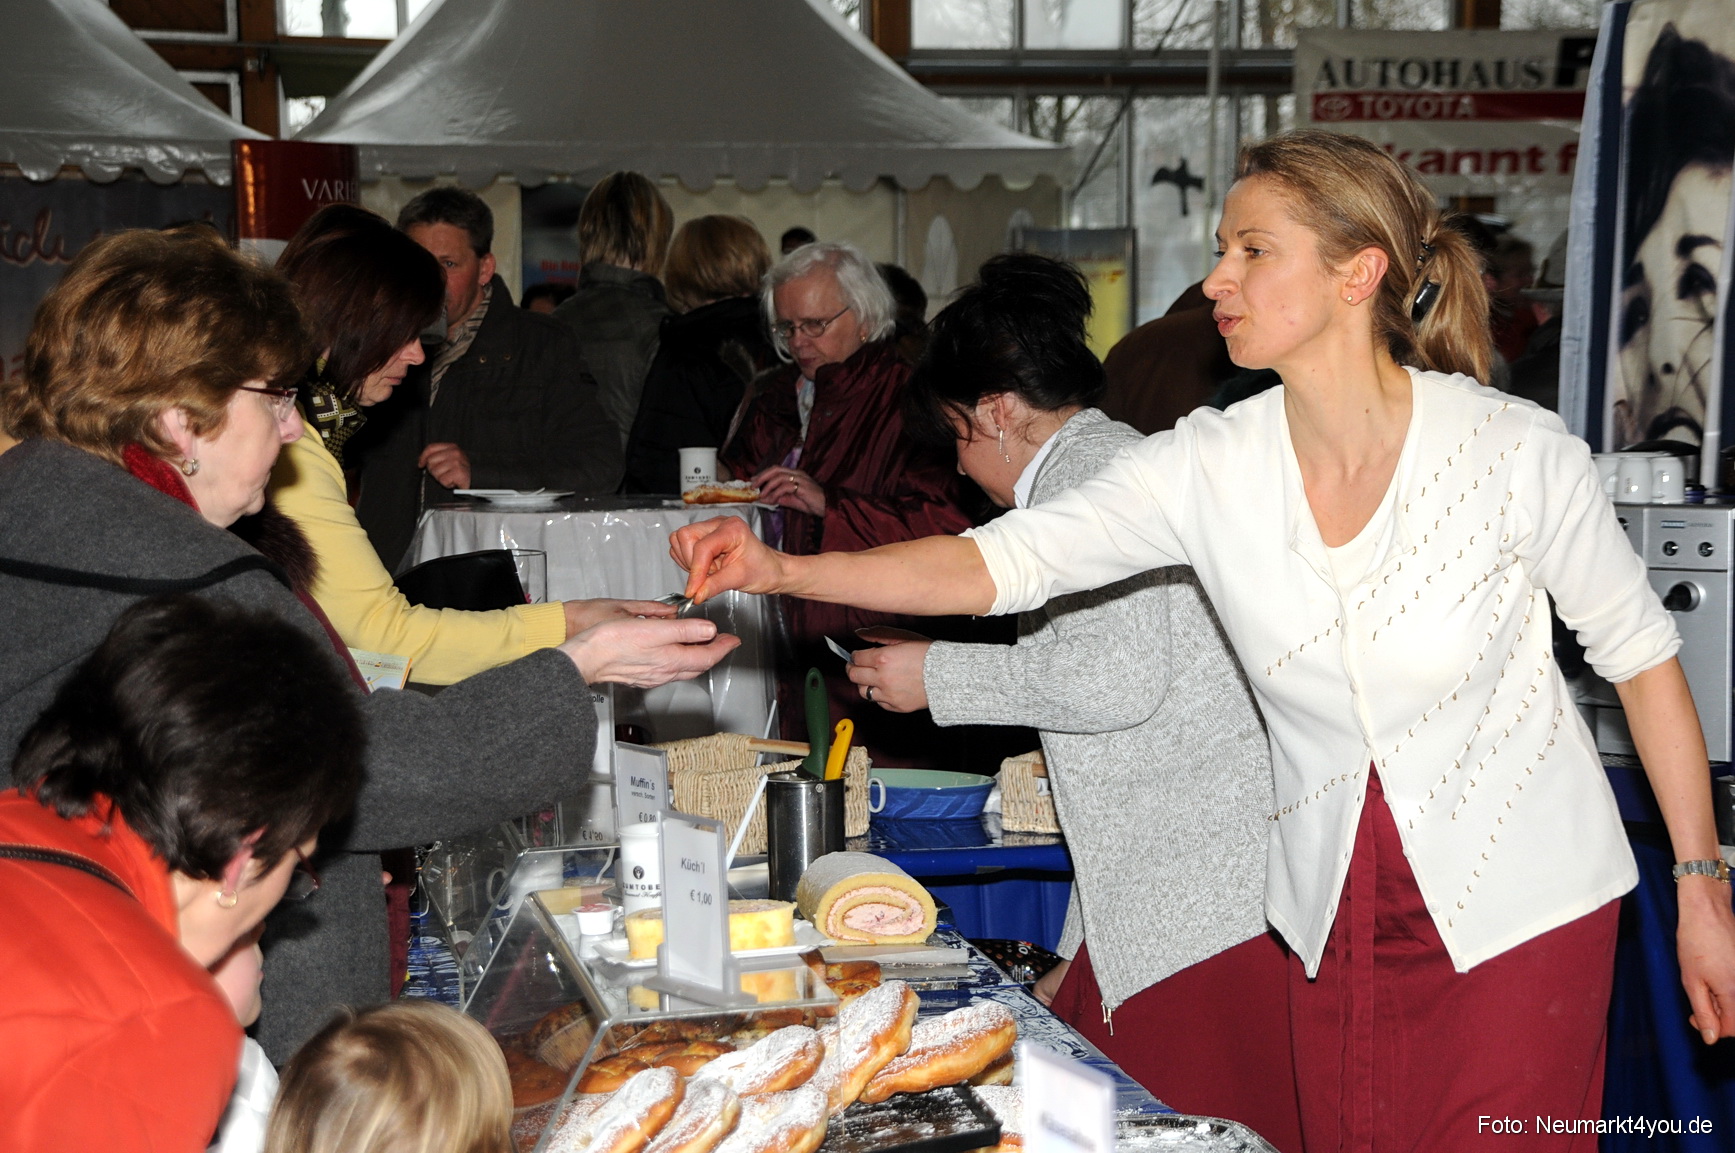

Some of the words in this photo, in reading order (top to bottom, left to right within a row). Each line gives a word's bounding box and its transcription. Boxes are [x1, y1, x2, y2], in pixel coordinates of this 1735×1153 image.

[1314, 55, 1547, 89] AUTOHAUS
[1357, 96, 1476, 121] TOYOTA
[690, 889, 696, 902] €
[697, 891, 713, 906] 1,00
